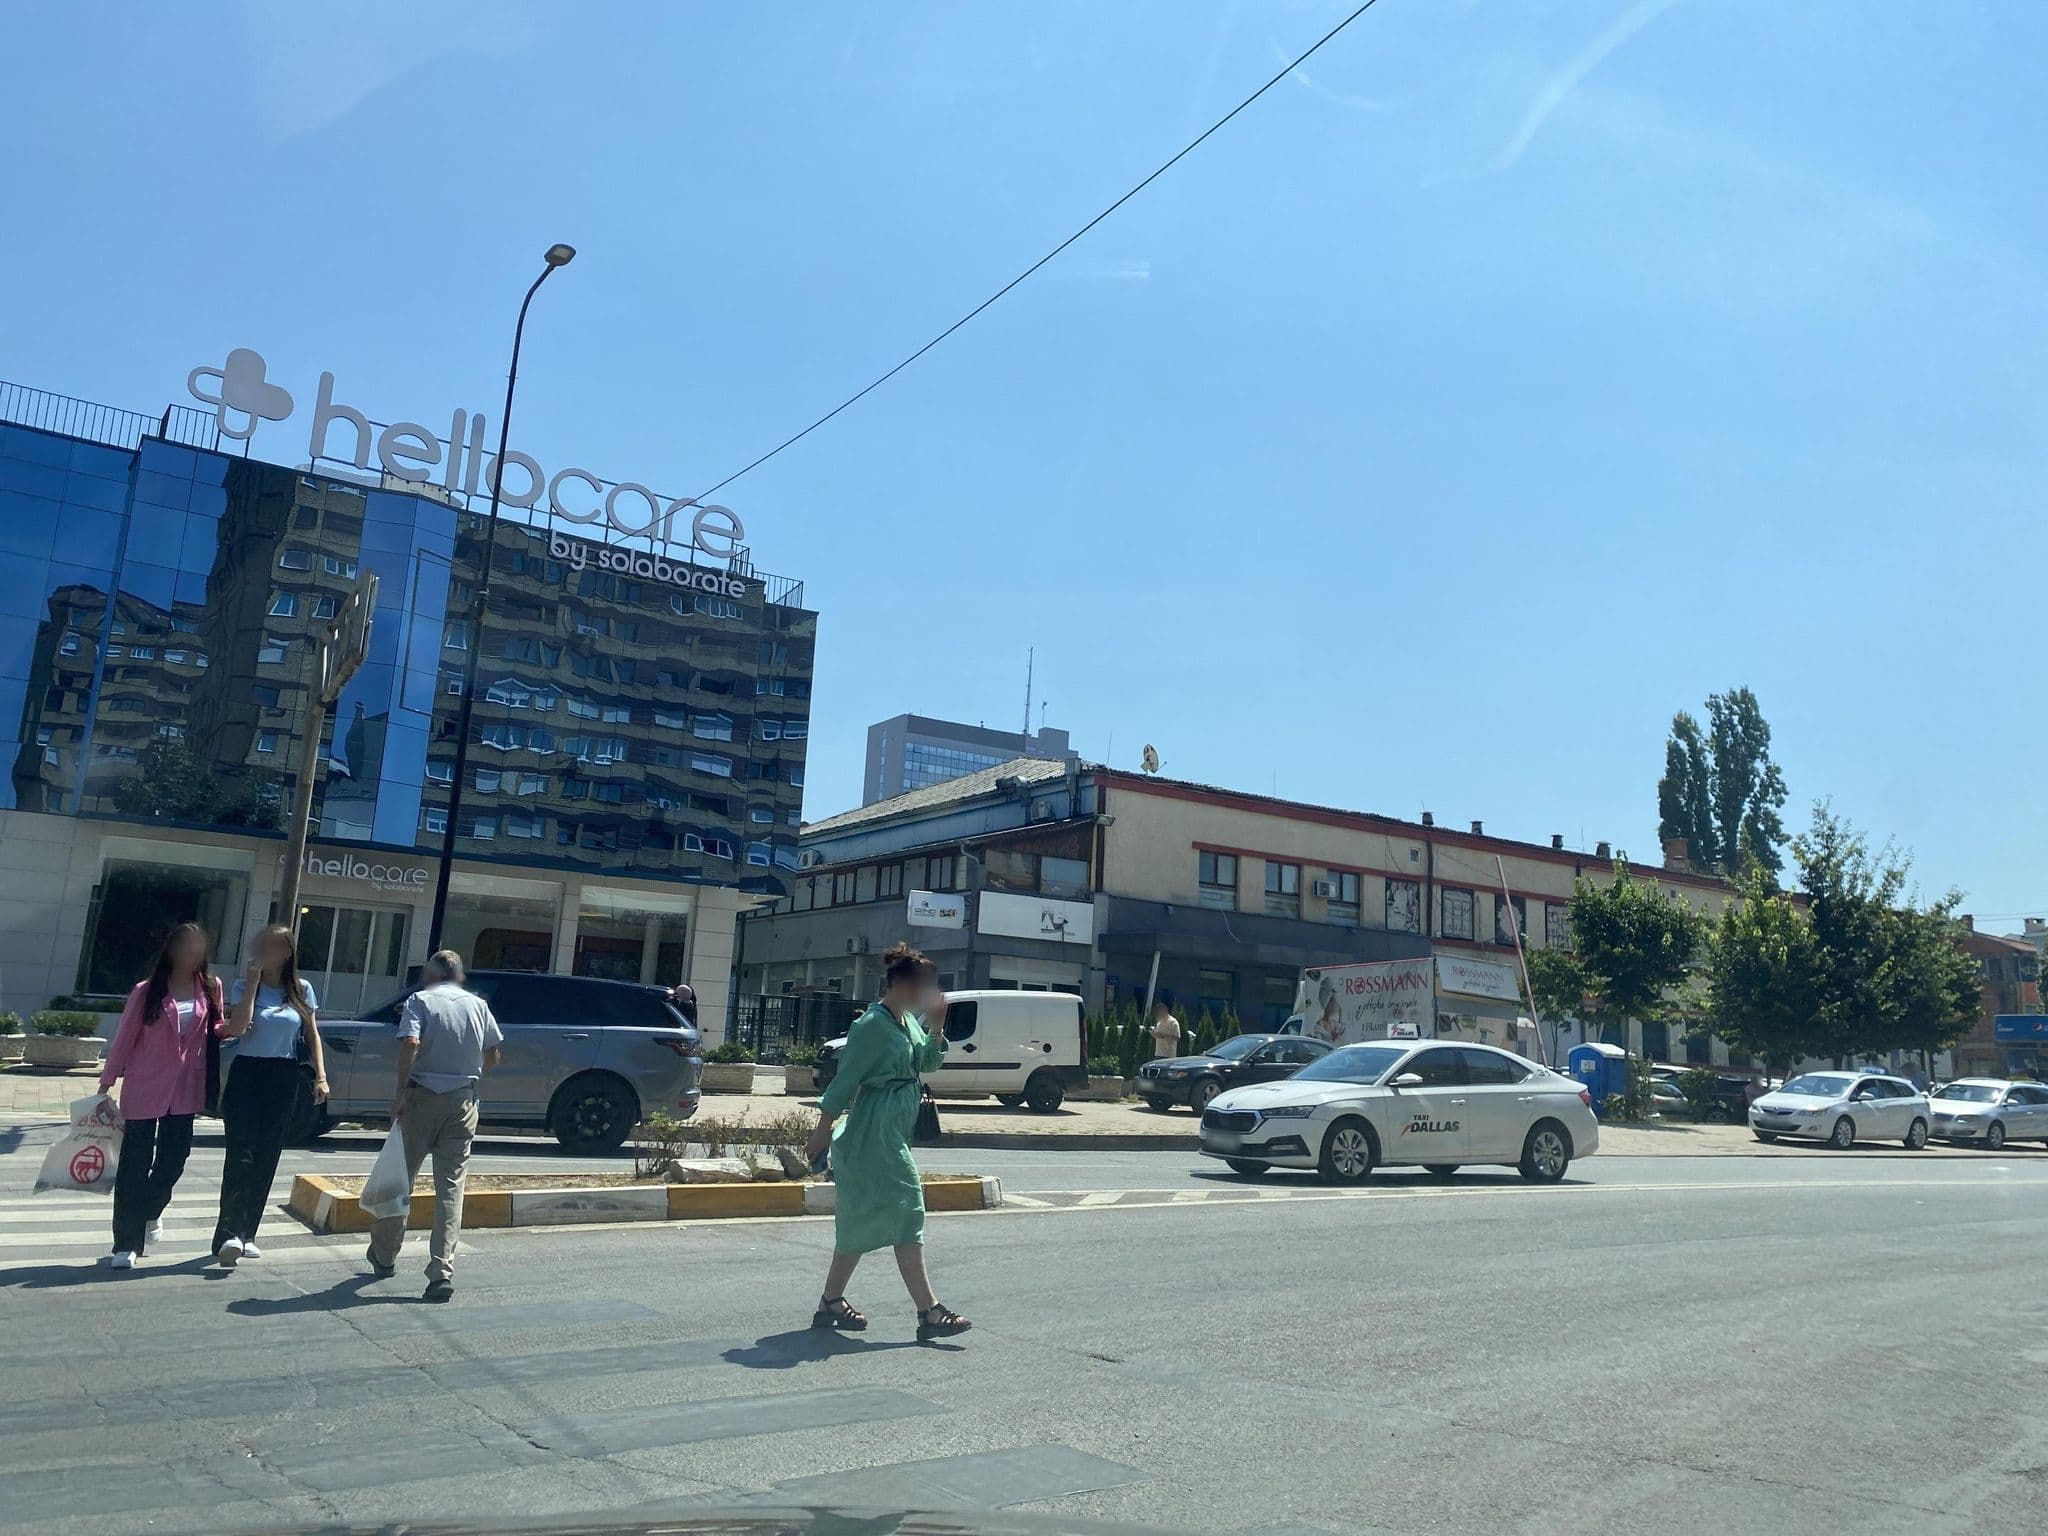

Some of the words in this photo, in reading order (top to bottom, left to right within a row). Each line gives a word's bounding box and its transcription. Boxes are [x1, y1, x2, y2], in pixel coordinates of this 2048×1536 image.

[309, 371, 745, 559] hellocare
[551, 528, 587, 571] by
[599, 548, 746, 599] solaborate
[307, 850, 429, 885] hellocare
[1345, 972, 1428, 996] ROSSMANN
[1410, 1121, 1460, 1133] DALLAS
